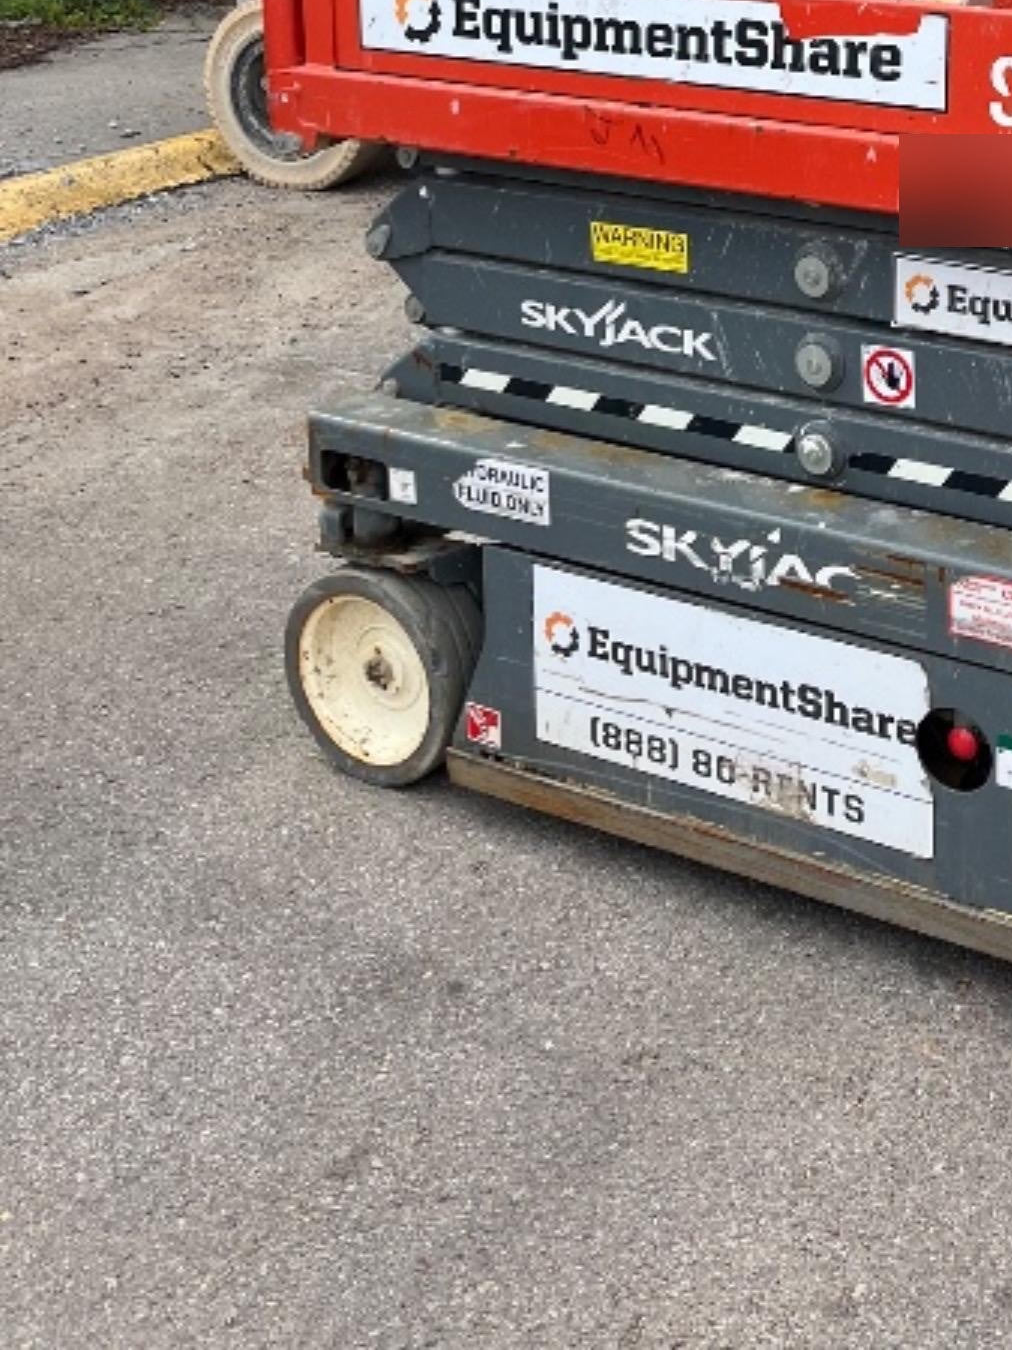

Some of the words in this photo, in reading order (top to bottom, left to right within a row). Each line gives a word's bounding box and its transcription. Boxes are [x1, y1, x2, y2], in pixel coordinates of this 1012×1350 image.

[592, 224, 685, 254] WARNING
[520, 299, 717, 362] SKYJACK
[468, 464, 544, 493] DRAULIC
[625, 518, 866, 607] SKYJAC
[587, 626, 918, 745] EquipmentShare
[590, 716, 679, 771] (888)
